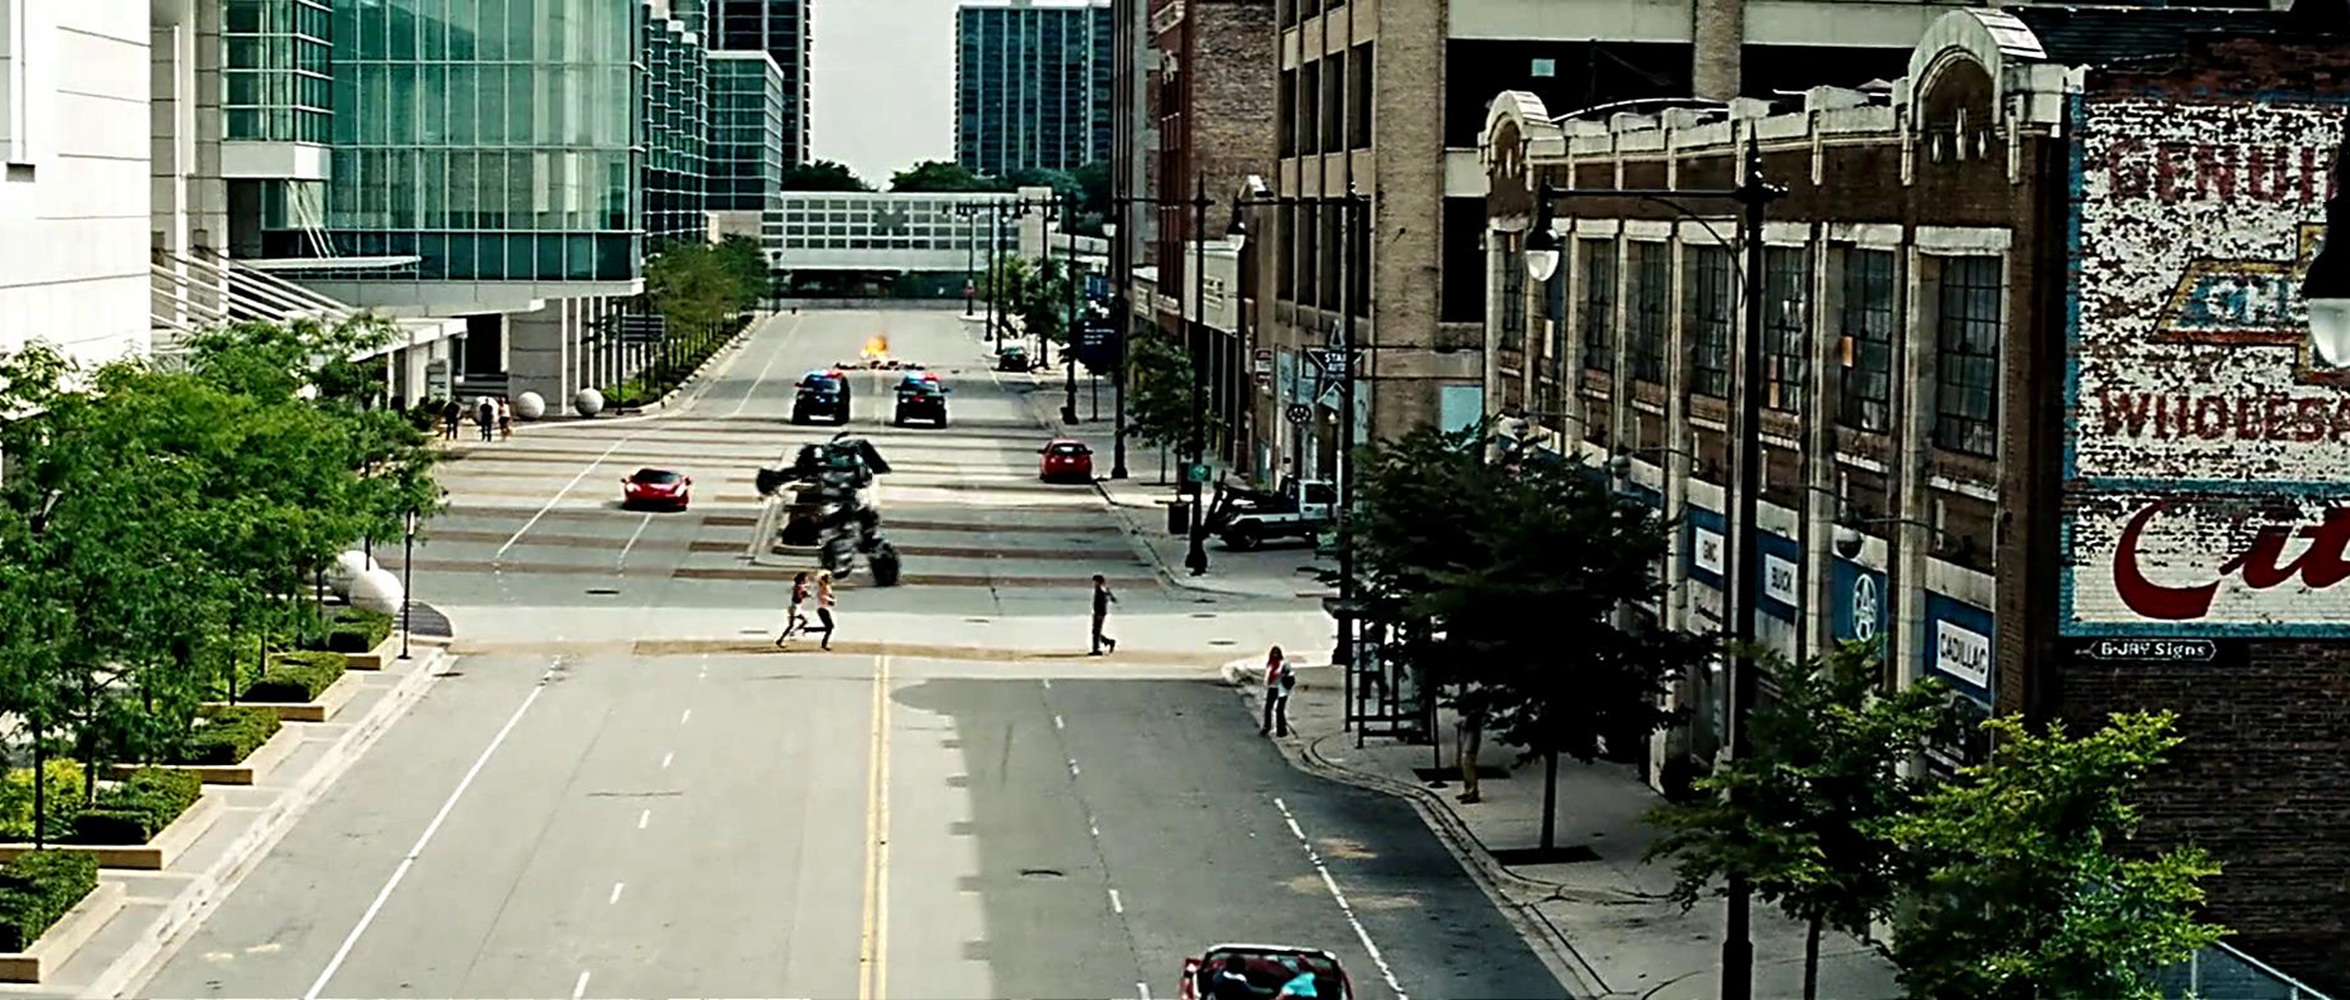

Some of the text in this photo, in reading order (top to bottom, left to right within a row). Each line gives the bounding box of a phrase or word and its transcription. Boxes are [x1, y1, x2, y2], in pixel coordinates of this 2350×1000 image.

[2107, 138, 2340, 203] GENUI
[1940, 632, 1987, 675] CADILLAC
[2155, 642, 2206, 659] Signs
